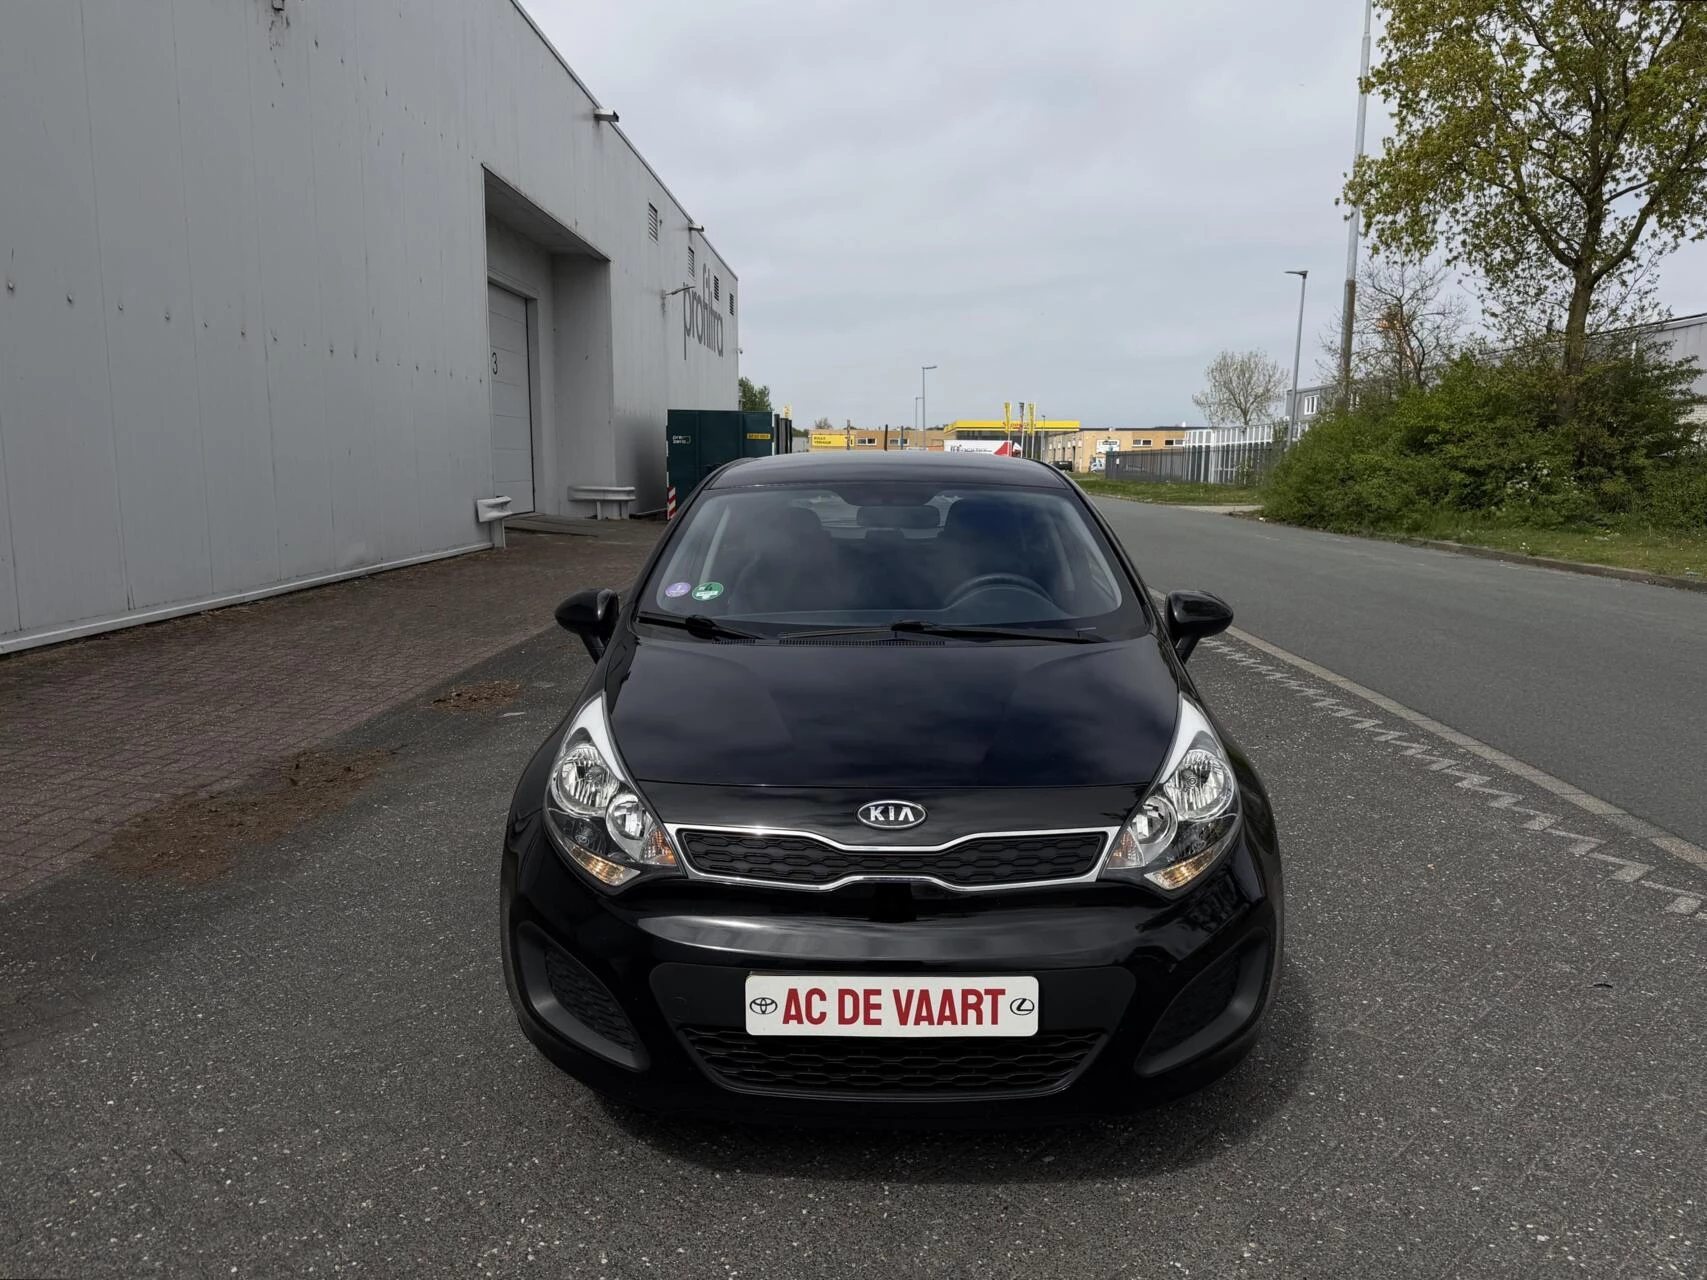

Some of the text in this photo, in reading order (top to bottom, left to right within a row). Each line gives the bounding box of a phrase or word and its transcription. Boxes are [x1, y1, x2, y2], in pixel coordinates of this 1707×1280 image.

[491, 351, 498, 375] 3
[869, 806, 915, 822] KIA
[782, 988, 1006, 1026] AC DE VAART
